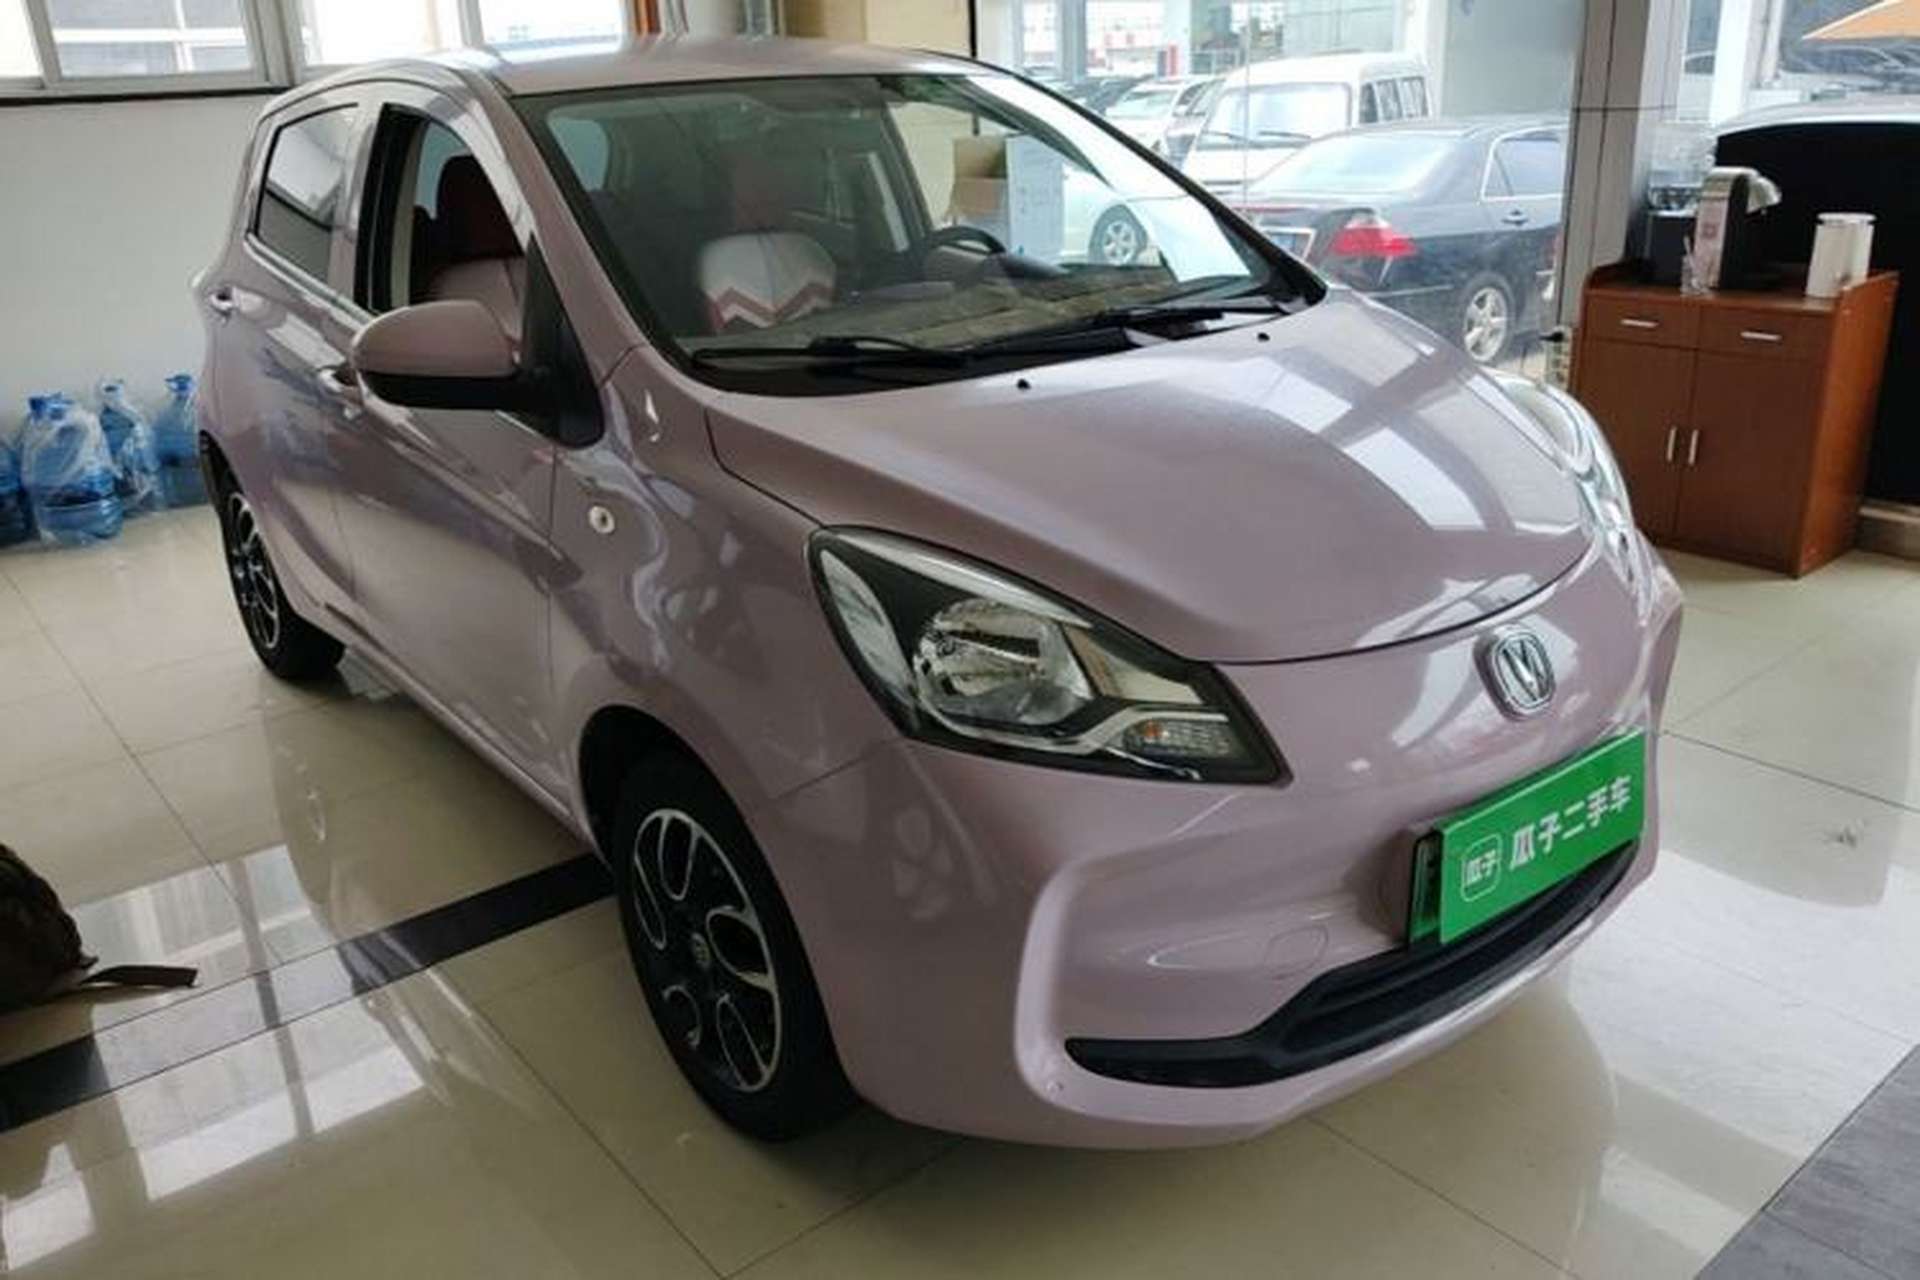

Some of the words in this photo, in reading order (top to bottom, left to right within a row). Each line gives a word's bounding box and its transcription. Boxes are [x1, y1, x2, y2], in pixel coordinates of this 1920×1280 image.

[1510, 775, 1632, 870] 瓜子二手车
[1465, 848, 1497, 887] 瓜子
